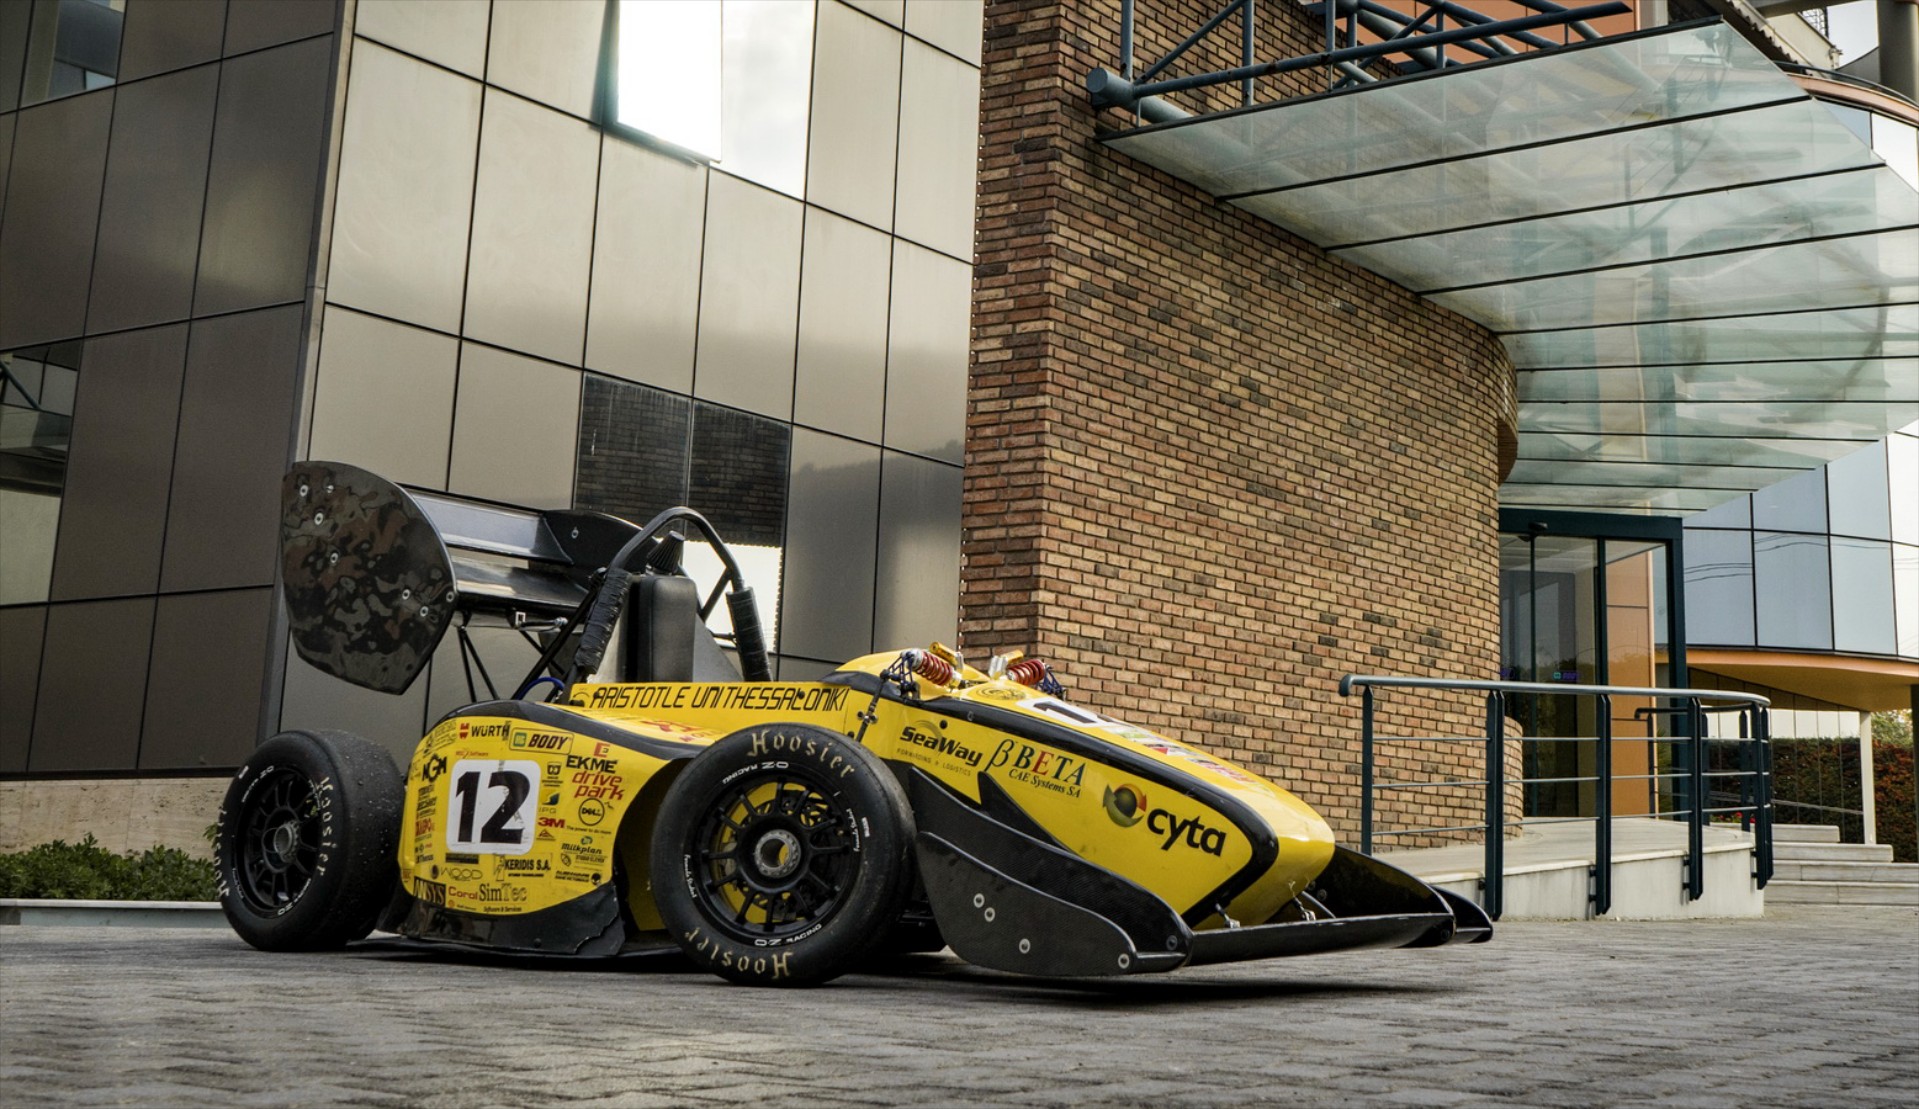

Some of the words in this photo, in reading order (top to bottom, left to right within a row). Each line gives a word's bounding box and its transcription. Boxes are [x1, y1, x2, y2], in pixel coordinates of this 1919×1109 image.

[589, 686, 691, 709] ARISTOTLE
[1033, 700, 1115, 724] 1
[471, 724, 510, 738] WÜRTH
[528, 733, 569, 750] BODY
[900, 726, 983, 767] SeaWay
[747, 729, 855, 778] Hoosier
[566, 755, 618, 774] EKME
[1012, 744, 1087, 787] BETA
[572, 770, 622, 787] drive
[1008, 768, 1030, 782] CAE
[1031, 775, 1066, 793] Systems
[1066, 785, 1081, 798] SA
[574, 784, 625, 800] park
[456, 770, 531, 844] 12
[538, 817, 565, 828] 3M
[1147, 808, 1227, 857] cyta
[561, 843, 602, 854] milkplan
[504, 859, 535, 870] KERIDIS
[536, 859, 552, 871] S.A.
[448, 886, 478, 900] Coral
[479, 882, 527, 902] SimTec
[685, 927, 793, 979] Hoosier
